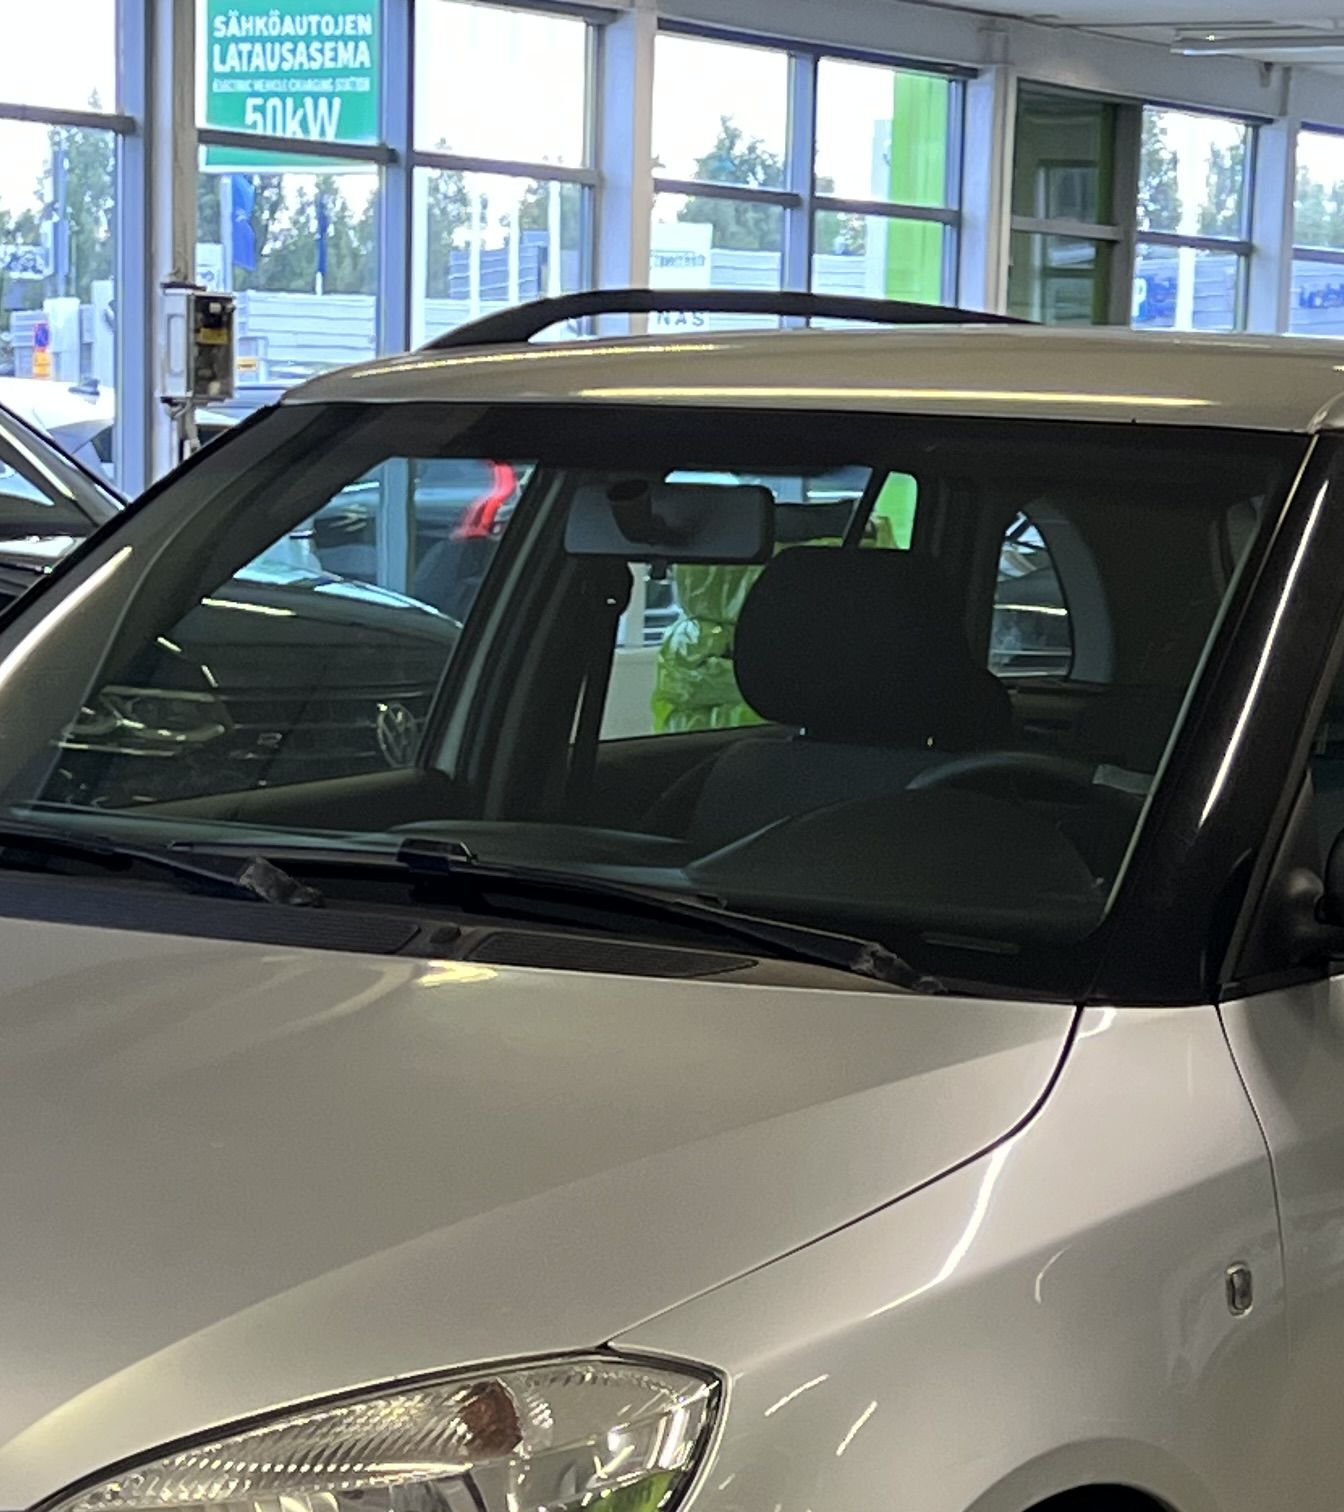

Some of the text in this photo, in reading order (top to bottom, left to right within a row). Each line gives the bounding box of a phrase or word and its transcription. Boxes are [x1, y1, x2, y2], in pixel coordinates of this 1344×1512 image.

[212, 9, 373, 38] SÄHKÖAUTOJEN
[212, 40, 372, 73] LATAUSASEMA
[244, 96, 342, 141] 50kW
